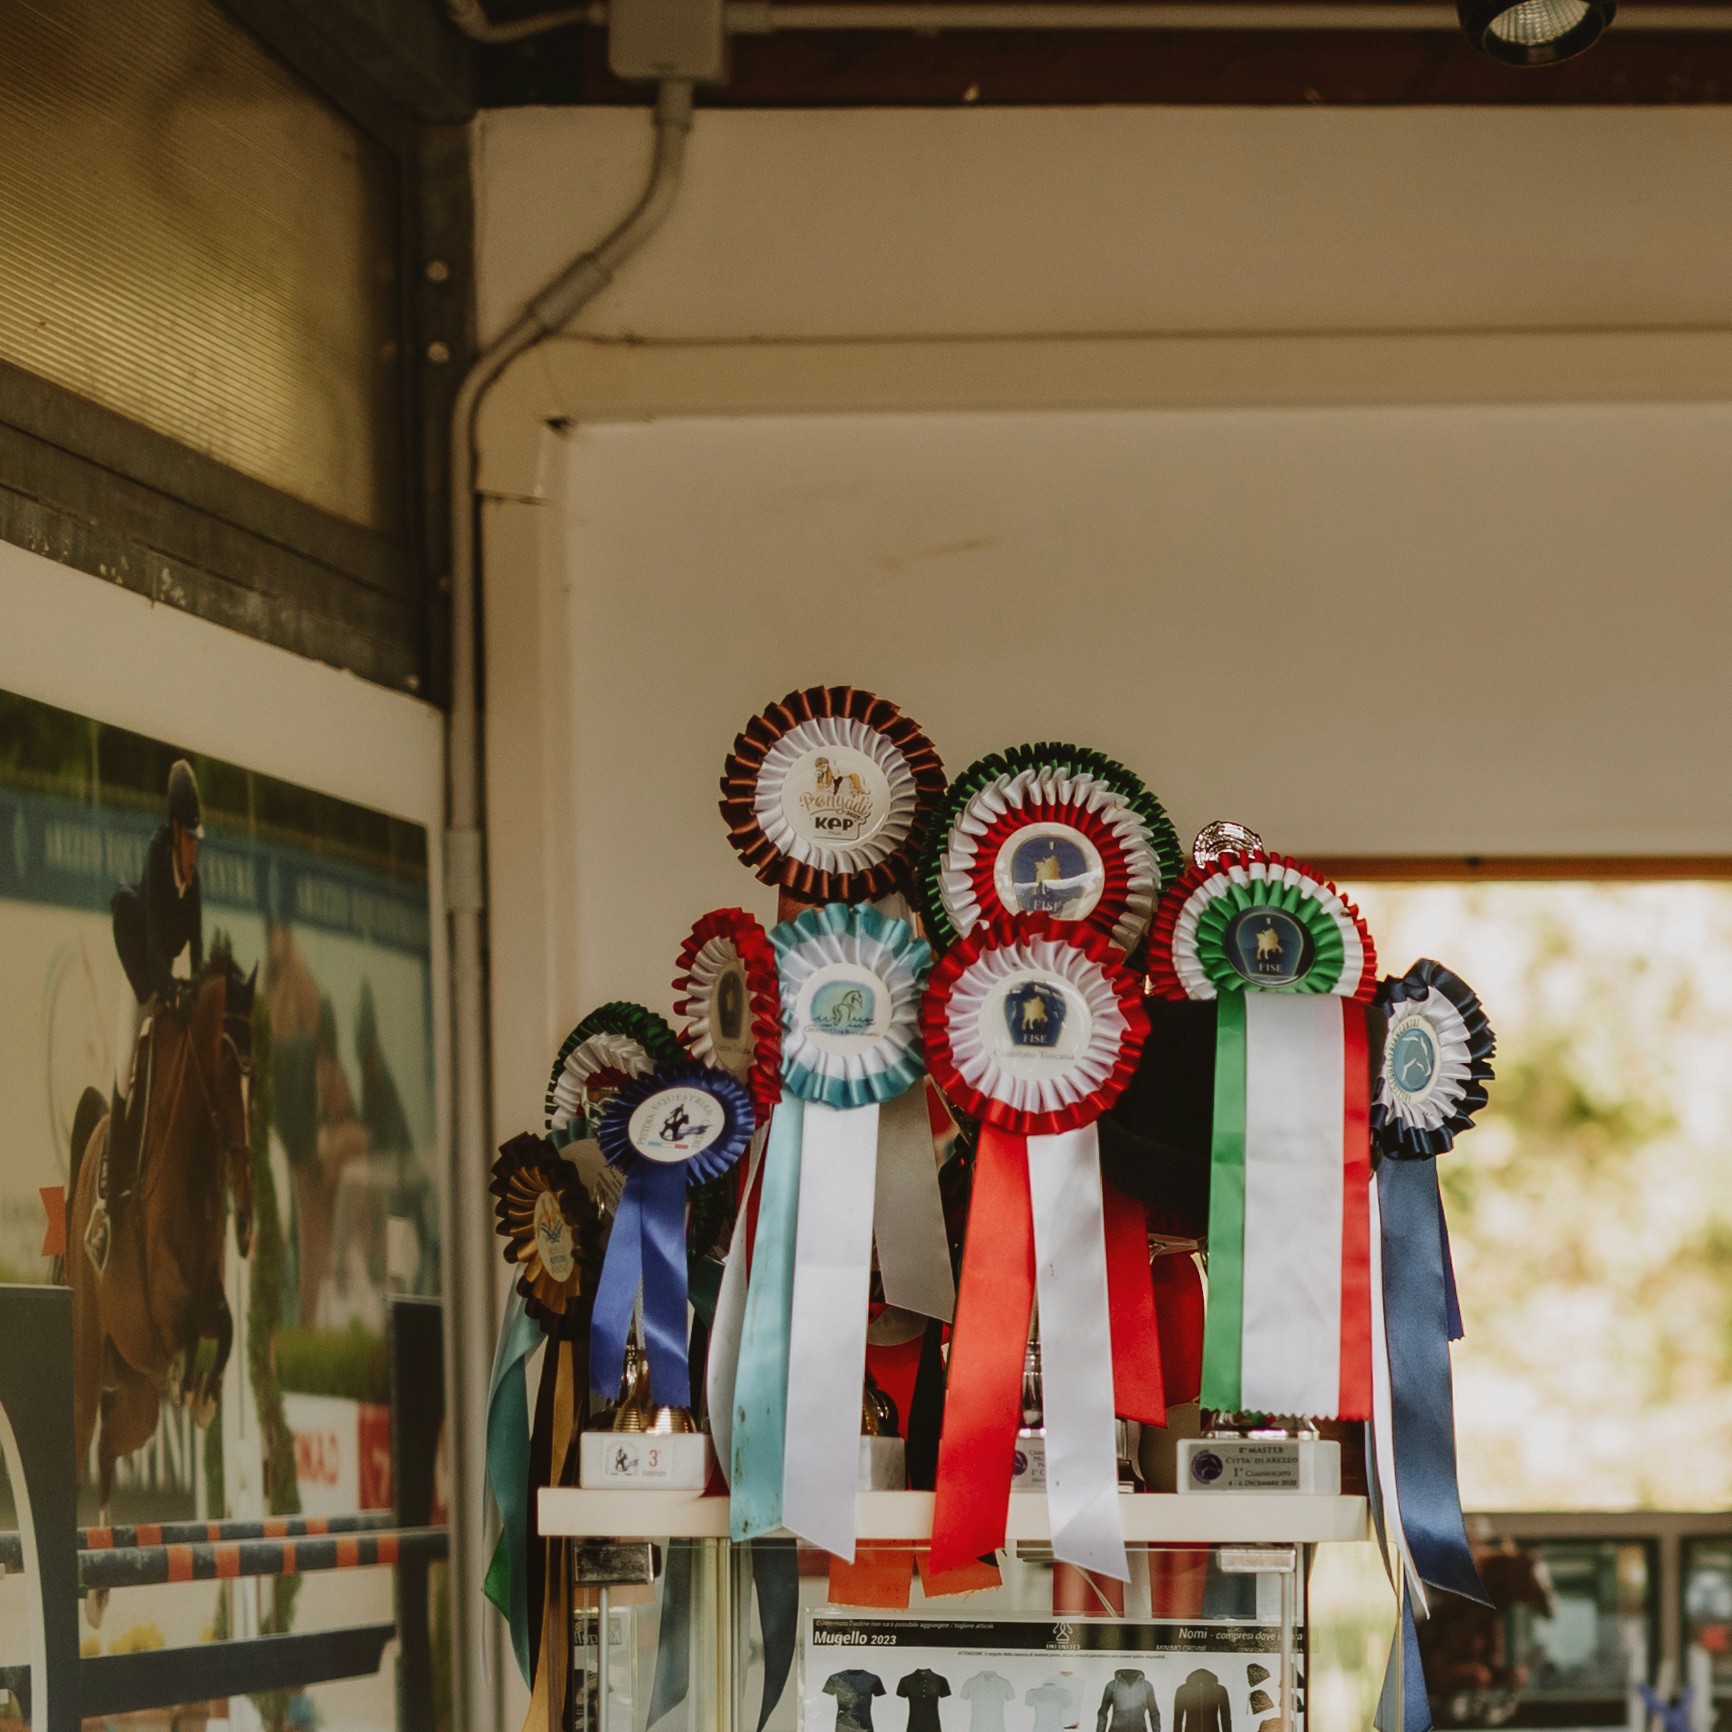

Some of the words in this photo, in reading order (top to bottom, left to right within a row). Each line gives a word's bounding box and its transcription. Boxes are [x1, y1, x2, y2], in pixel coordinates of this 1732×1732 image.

[1258, 963, 1283, 973] FISE
[1022, 1033, 1048, 1043] FISE
[814, 1630, 868, 1646] Mugello
[870, 1634, 897, 1645] 2023
[1178, 1627, 1208, 1640] Nomi
[1254, 1631, 1277, 1642] dove
